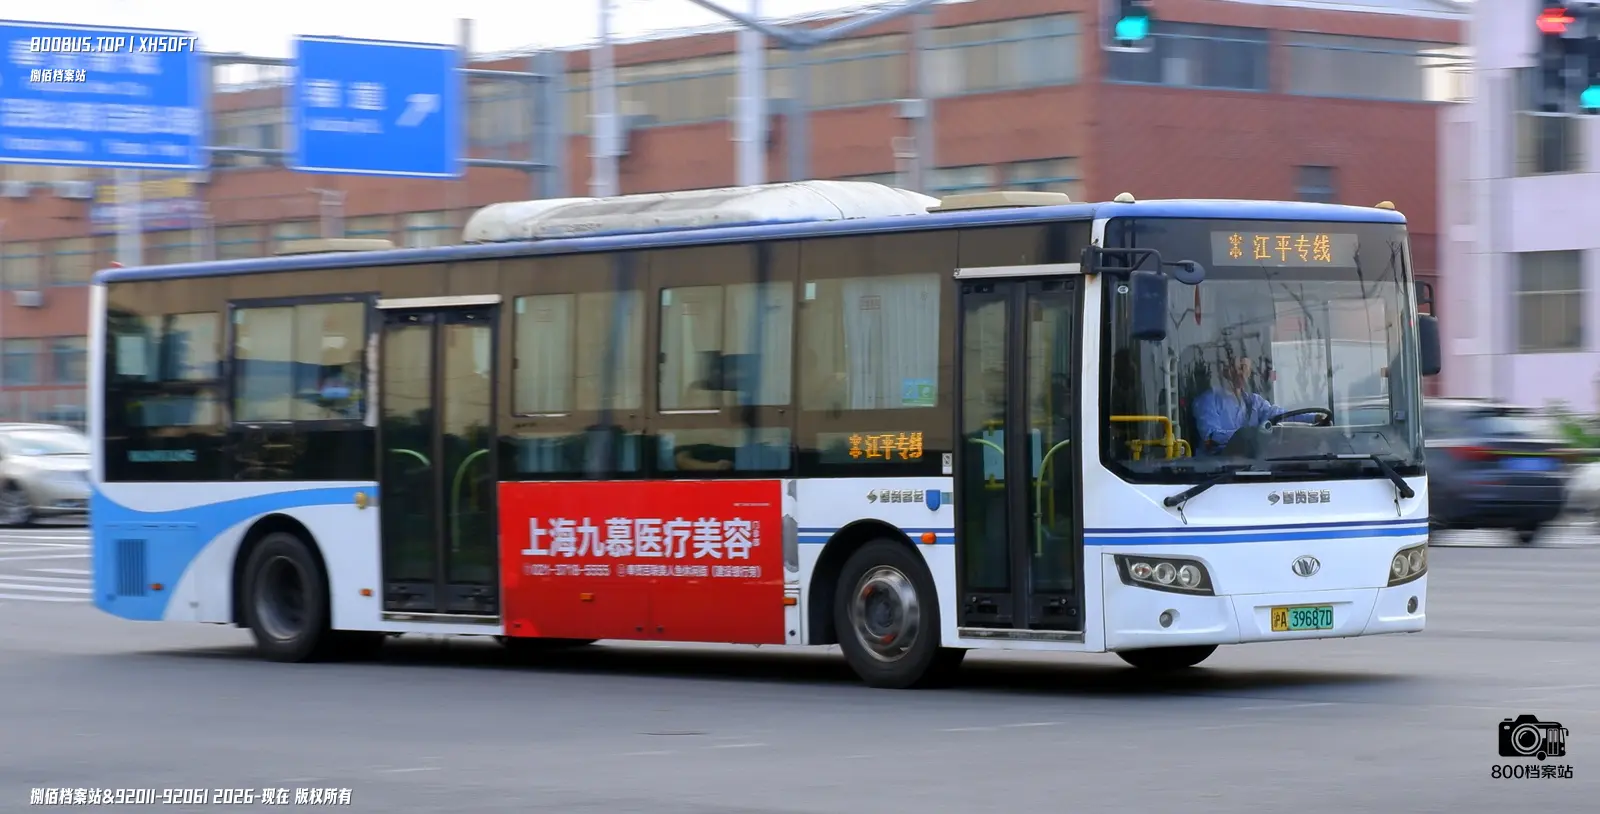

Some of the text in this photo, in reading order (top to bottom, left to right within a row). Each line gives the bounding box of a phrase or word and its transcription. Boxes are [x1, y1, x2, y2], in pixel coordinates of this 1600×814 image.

[1253, 233, 1332, 262] 江平专线
[865, 431, 924, 460] 江平专线
[521, 516, 753, 560] 上海九慕医疗美容
